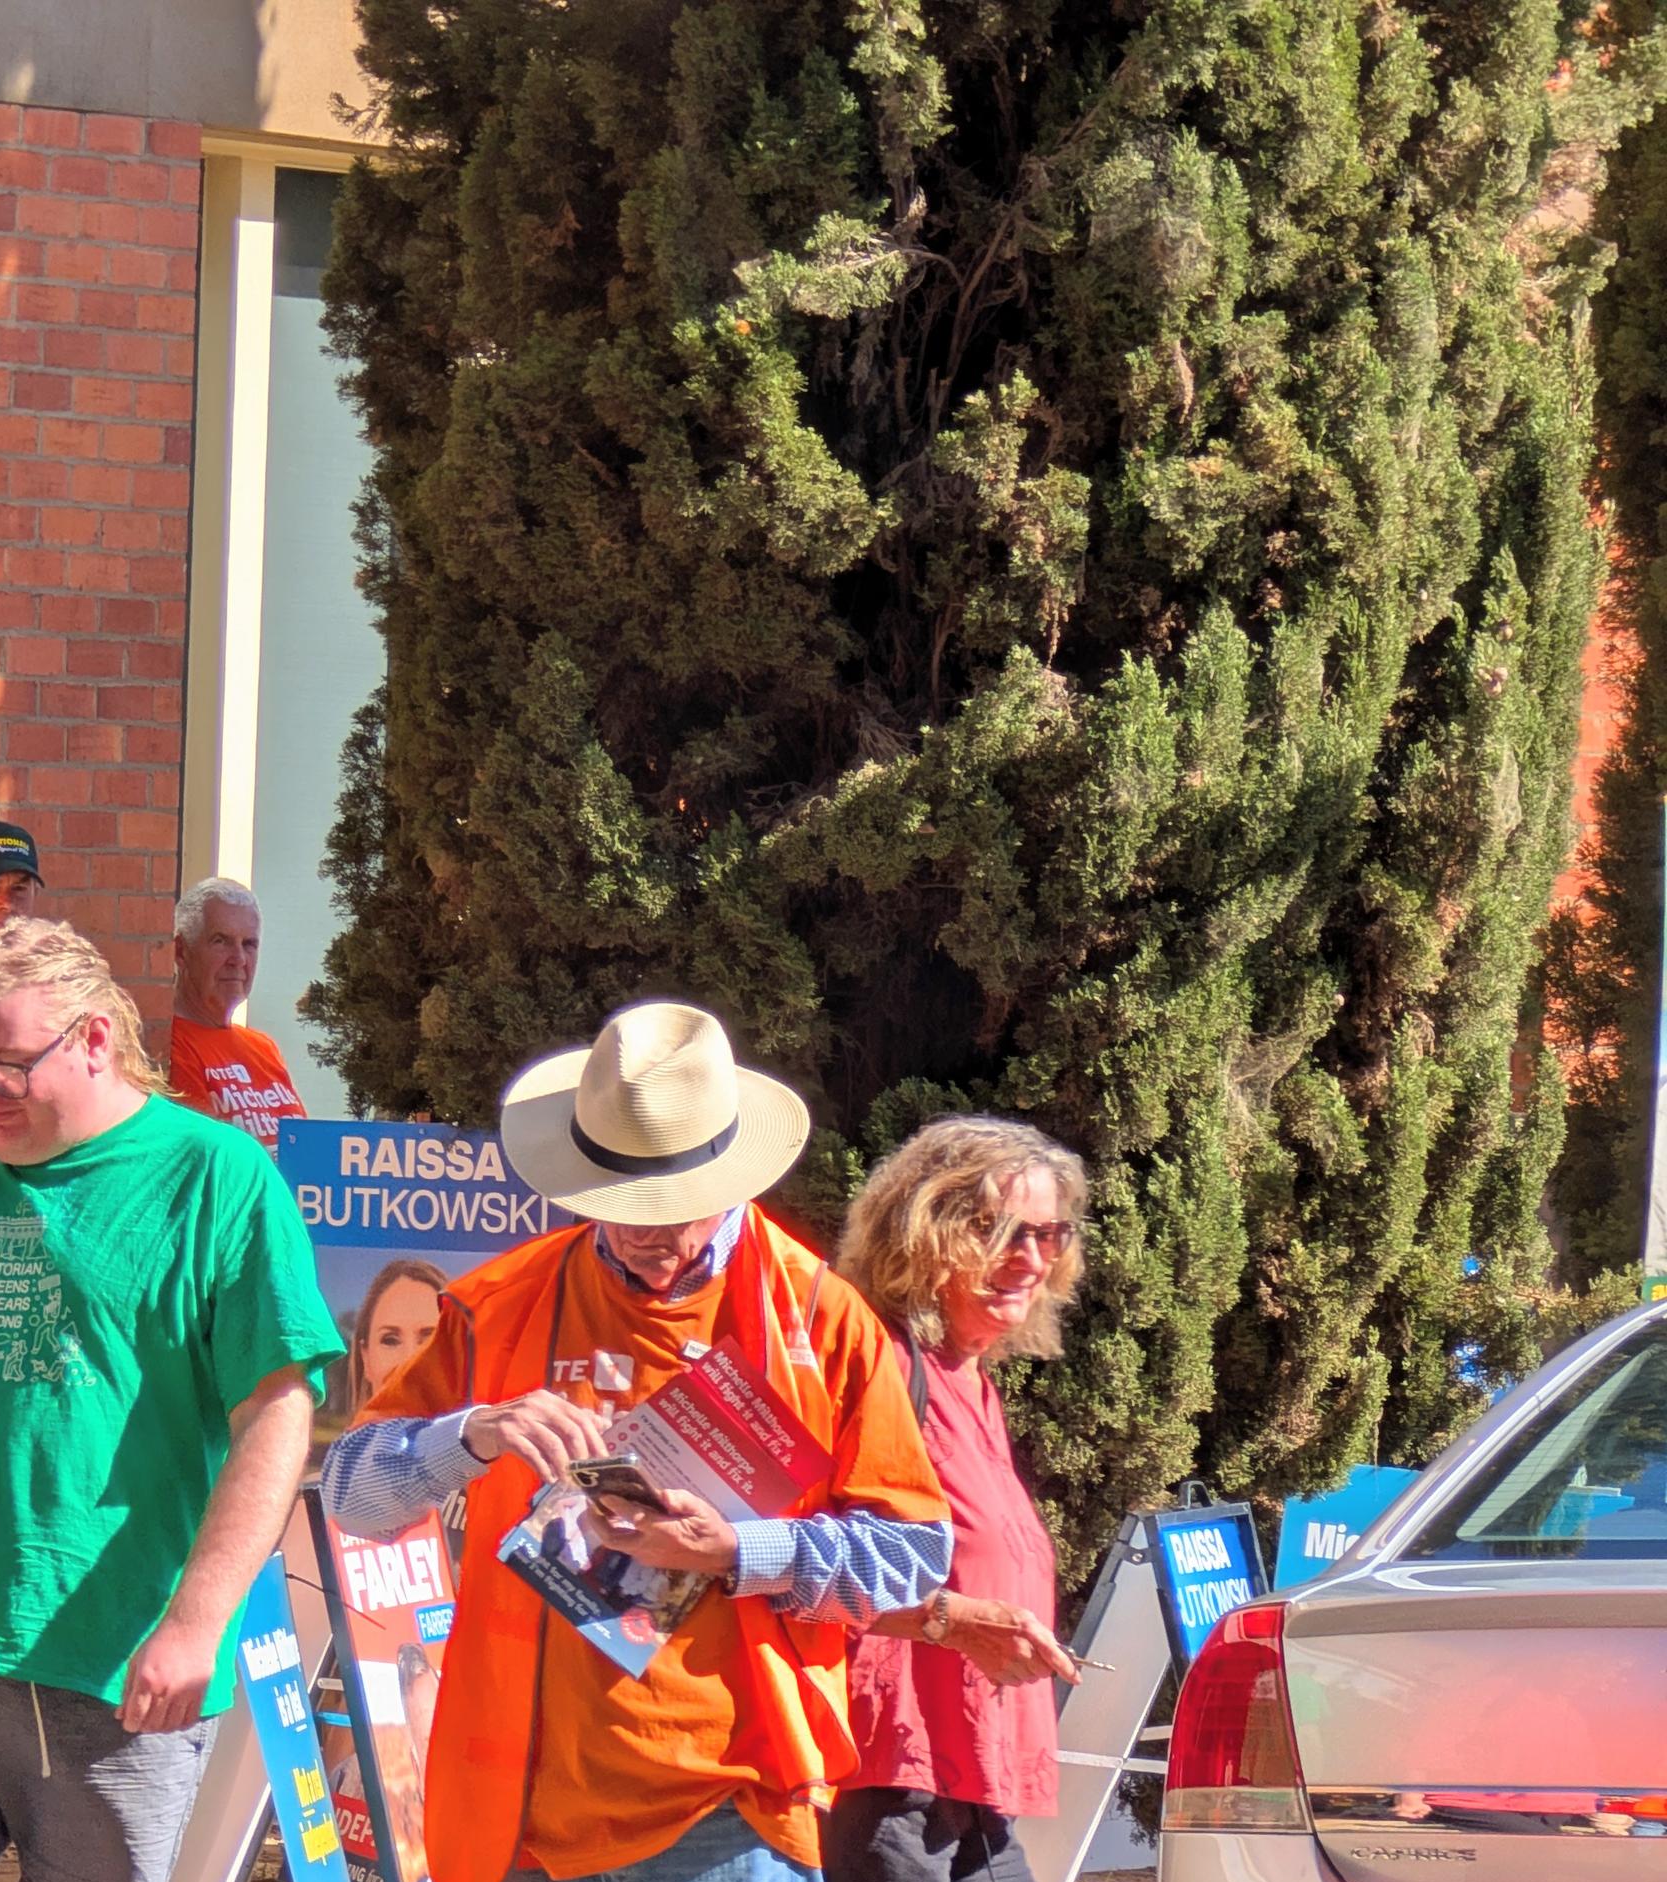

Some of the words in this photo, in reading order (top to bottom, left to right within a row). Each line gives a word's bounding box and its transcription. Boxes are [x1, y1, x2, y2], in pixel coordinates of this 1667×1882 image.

[340, 1136, 507, 1182] RAISSA
[297, 1185, 548, 1234] BUTKOWSKI
[699, 1360, 725, 1385] will
[715, 1381, 747, 1413] fight
[741, 1408, 754, 1421] it
[748, 1418, 771, 1442] and
[766, 1437, 784, 1456] fix
[710, 1349, 759, 1401] Michelle
[749, 1396, 799, 1450] Milthorpe
[657, 1395, 681, 1420] will
[674, 1413, 704, 1444] fight
[699, 1437, 714, 1452] it
[707, 1445, 733, 1472] and
[726, 1465, 746, 1485] fix
[668, 1385, 712, 1432] Michelle
[708, 1425, 757, 1478] Milthorpe
[1170, 1528, 1231, 1574] RAISSA
[1304, 1522, 1360, 1560] Mic
[343, 1537, 443, 1612] FARLEY
[418, 1608, 453, 1638] FARRE
[1178, 1578, 1252, 1628] UTKOWSKI
